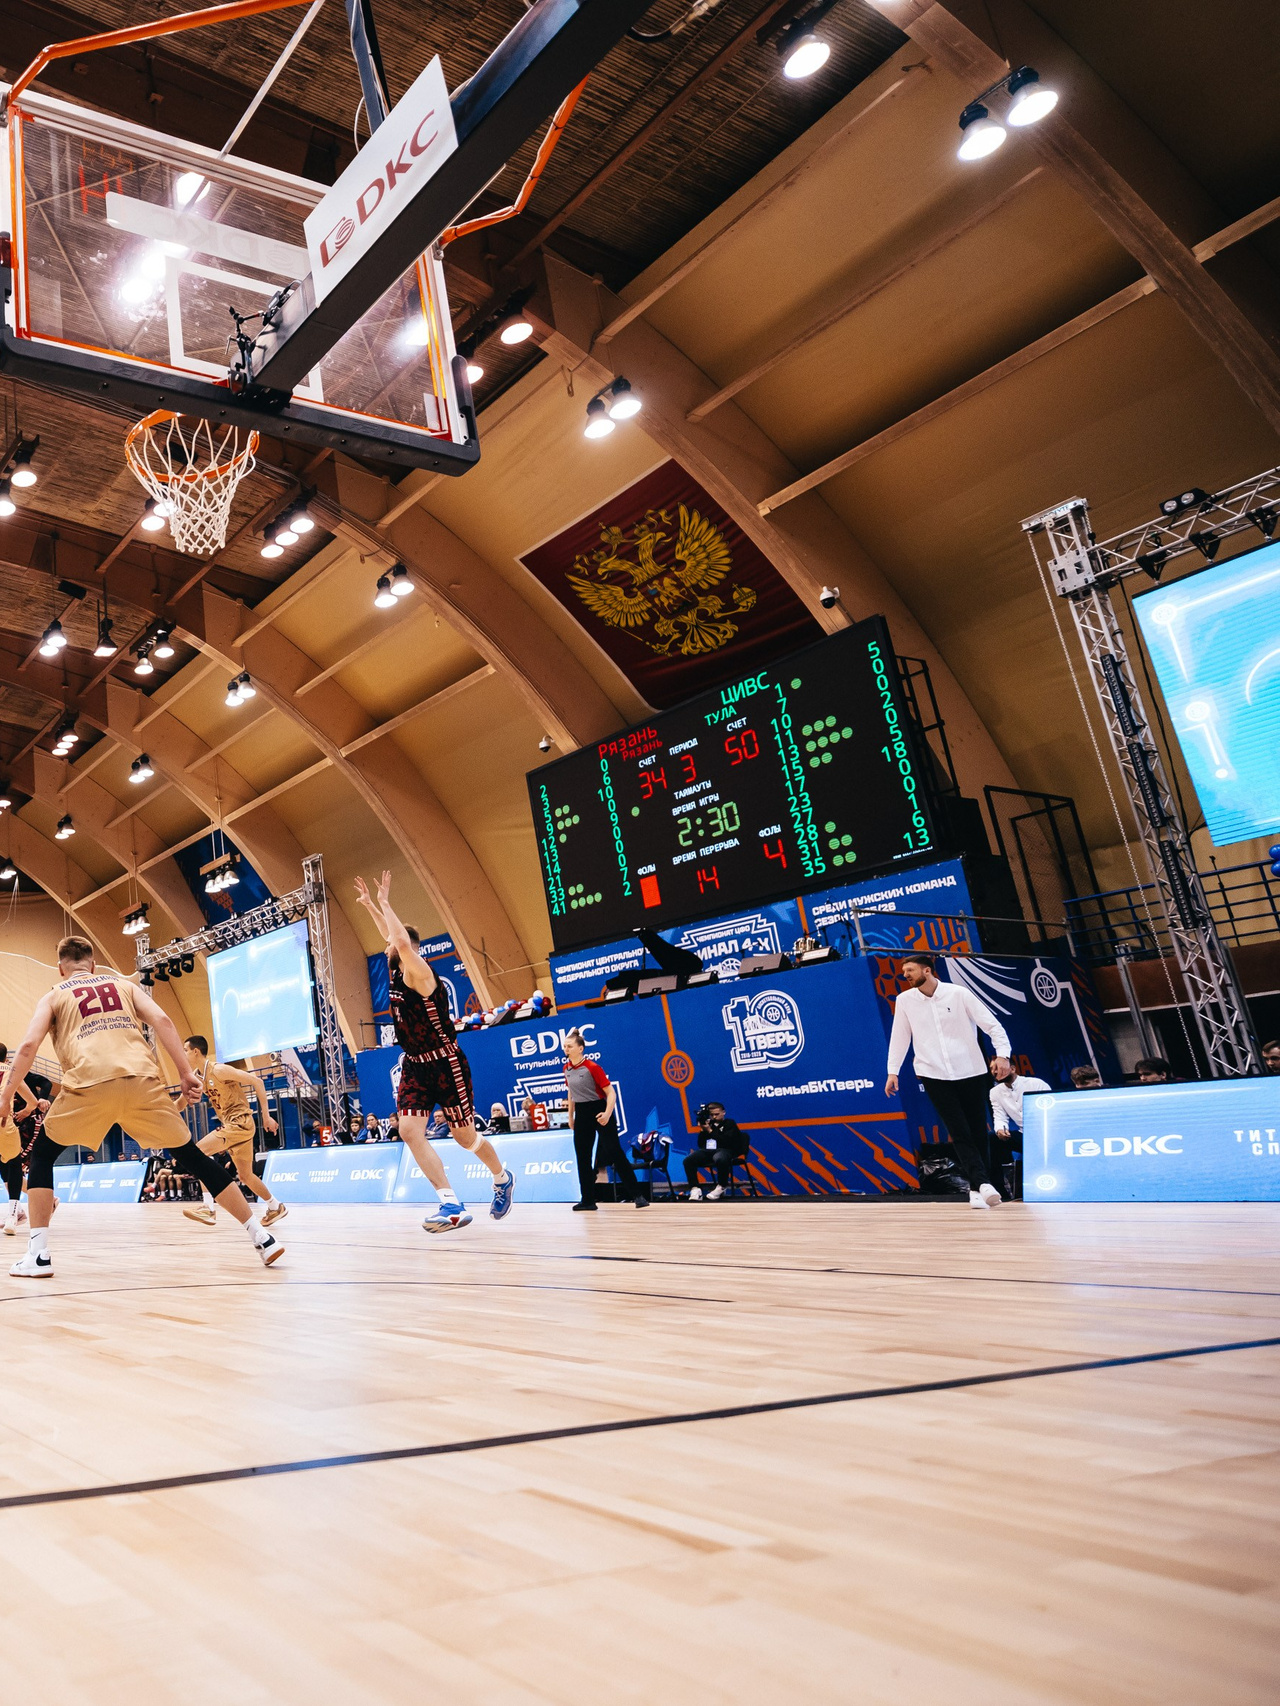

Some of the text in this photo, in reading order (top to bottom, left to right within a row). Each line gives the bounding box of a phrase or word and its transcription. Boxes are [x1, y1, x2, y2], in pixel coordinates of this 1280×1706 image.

[356, 109, 438, 226] DKC
[868, 641, 880, 659] 5
[872, 658, 884, 674] 0
[720, 671, 770, 705] ЦИВС
[775, 683, 783, 698] 1
[876, 674, 889, 691] 0
[776, 697, 787, 714] 7
[880, 691, 894, 709] 2
[704, 705, 738, 726] ТУЛА
[726, 716, 747, 732] СЧЕТ
[771, 713, 792, 734] 10
[885, 708, 898, 725] 0
[774, 729, 794, 748] 11
[889, 724, 903, 743] 5
[669, 738, 698, 756] ПЕРИОД
[724, 729, 760, 766] 50
[777, 745, 800, 764] 13
[600, 758, 608, 772] 0
[638, 754, 657, 768] СЧЕТ
[680, 754, 697, 783] 3
[898, 758, 911, 775] 0
[603, 772, 611, 786] 6
[781, 760, 803, 781] 15
[540, 784, 547, 799] 2
[638, 767, 668, 800] 34
[785, 776, 806, 796] 17
[902, 775, 916, 793] 0
[598, 785, 614, 802] 10
[908, 793, 918, 810] 1
[543, 798, 550, 811] 3
[607, 799, 616, 813] 0
[672, 793, 720, 816] ВРЕМЯ ИГРЫ
[787, 792, 811, 813] 23
[544, 811, 552, 823] 5
[610, 812, 619, 827] 9
[677, 800, 741, 847] 2:30
[791, 807, 813, 829] 27
[912, 810, 925, 828] 6
[546, 823, 554, 836] 9
[613, 826, 621, 840] 0
[759, 824, 781, 837] ФОЛЫ
[794, 824, 819, 845] 28
[903, 827, 930, 849] 13
[542, 836, 557, 850] 12
[615, 839, 624, 853] 0
[672, 837, 740, 866] ВРЕМЯ ПЕРЕРЫВА
[799, 840, 820, 861] 31
[544, 849, 558, 864] 13
[618, 853, 626, 867] 0
[763, 838, 787, 869] 4
[546, 862, 561, 876] 14
[620, 867, 628, 881] 7
[637, 864, 656, 876] ФОЛЫ
[802, 857, 826, 878] 35
[547, 875, 562, 890] 21
[696, 865, 720, 894] 14
[550, 888, 565, 903] 33
[623, 881, 632, 897] 2
[812, 875, 957, 916] СРЕДИ МУЖСКИХ КОМАНД
[552, 902, 567, 916] 41
[696, 929, 734, 943] ЧЕМПИОНАТ
[694, 937, 739, 961] ИНАЛ
[555, 946, 651, 975] ЧЕМПИОНАТ ЦЕНТРАЛЬНО
[557, 959, 640, 984] ФЕДЕРАЛЬНОГО ОКРУГА
[72, 983, 123, 1019] 28
[80, 1016, 131, 1032] ПРАВИТЕЛЬСТВО
[746, 1031, 797, 1052] ТВЕРЬ
[514, 1057, 560, 1071] Титульный
[530, 1084, 568, 1095] ЧЕМПИОНА
[756, 1078, 874, 1098] #СемьяБКТверь
[534, 1108, 546, 1125] 5
[322, 1130, 330, 1142] 5
[1103, 1134, 1184, 1156] DKC
[361, 1169, 384, 1180] DKC
[540, 1160, 574, 1174] DKC
[281, 1172, 300, 1182] DKC
